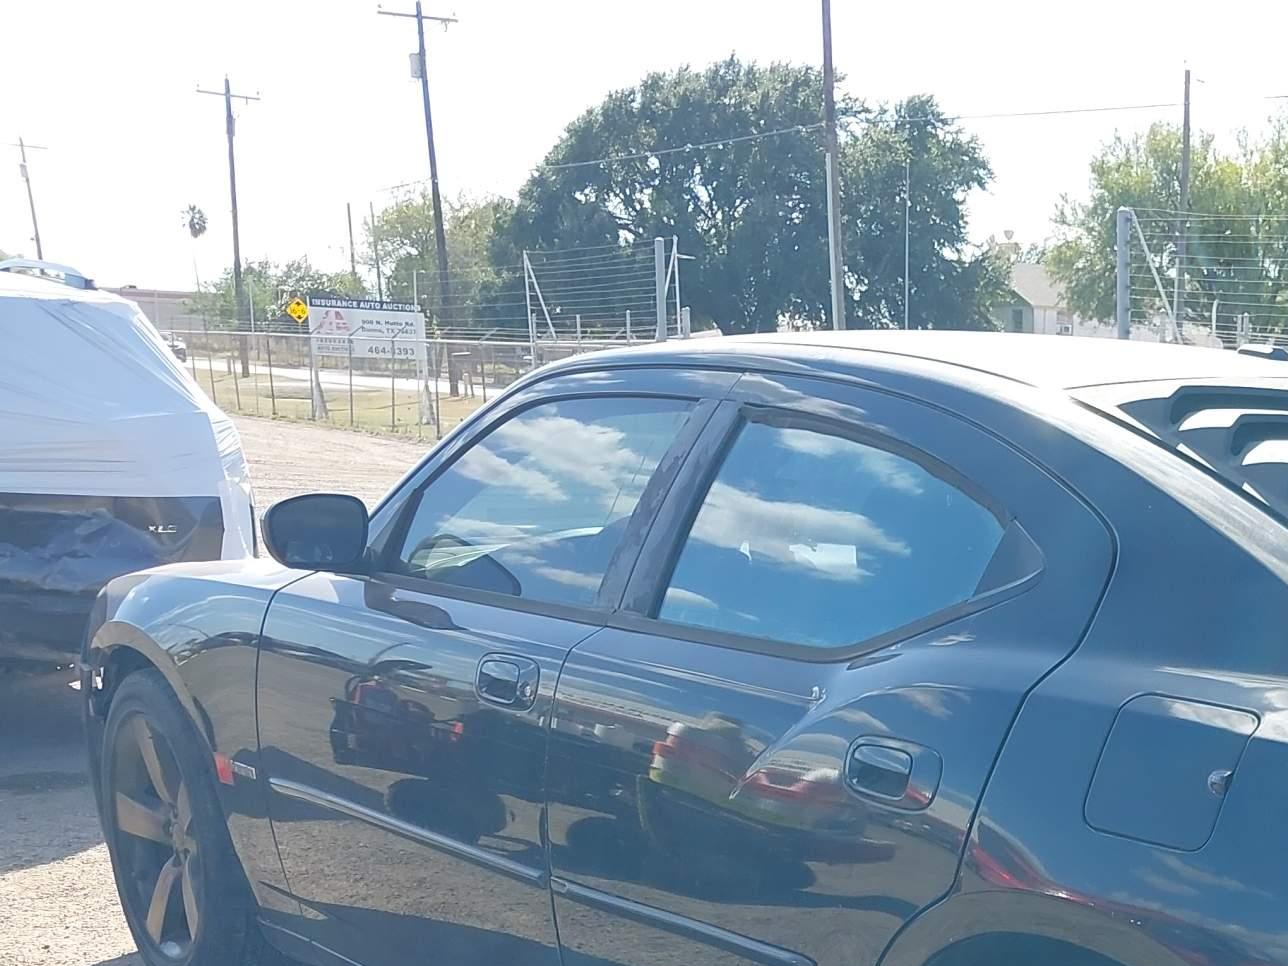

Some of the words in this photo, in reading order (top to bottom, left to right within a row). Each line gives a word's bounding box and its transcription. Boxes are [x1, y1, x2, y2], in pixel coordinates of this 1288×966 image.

[311, 298, 358, 308] INSURANCE
[359, 301, 380, 310] AUTO
[368, 346, 415, 356] 464-393
